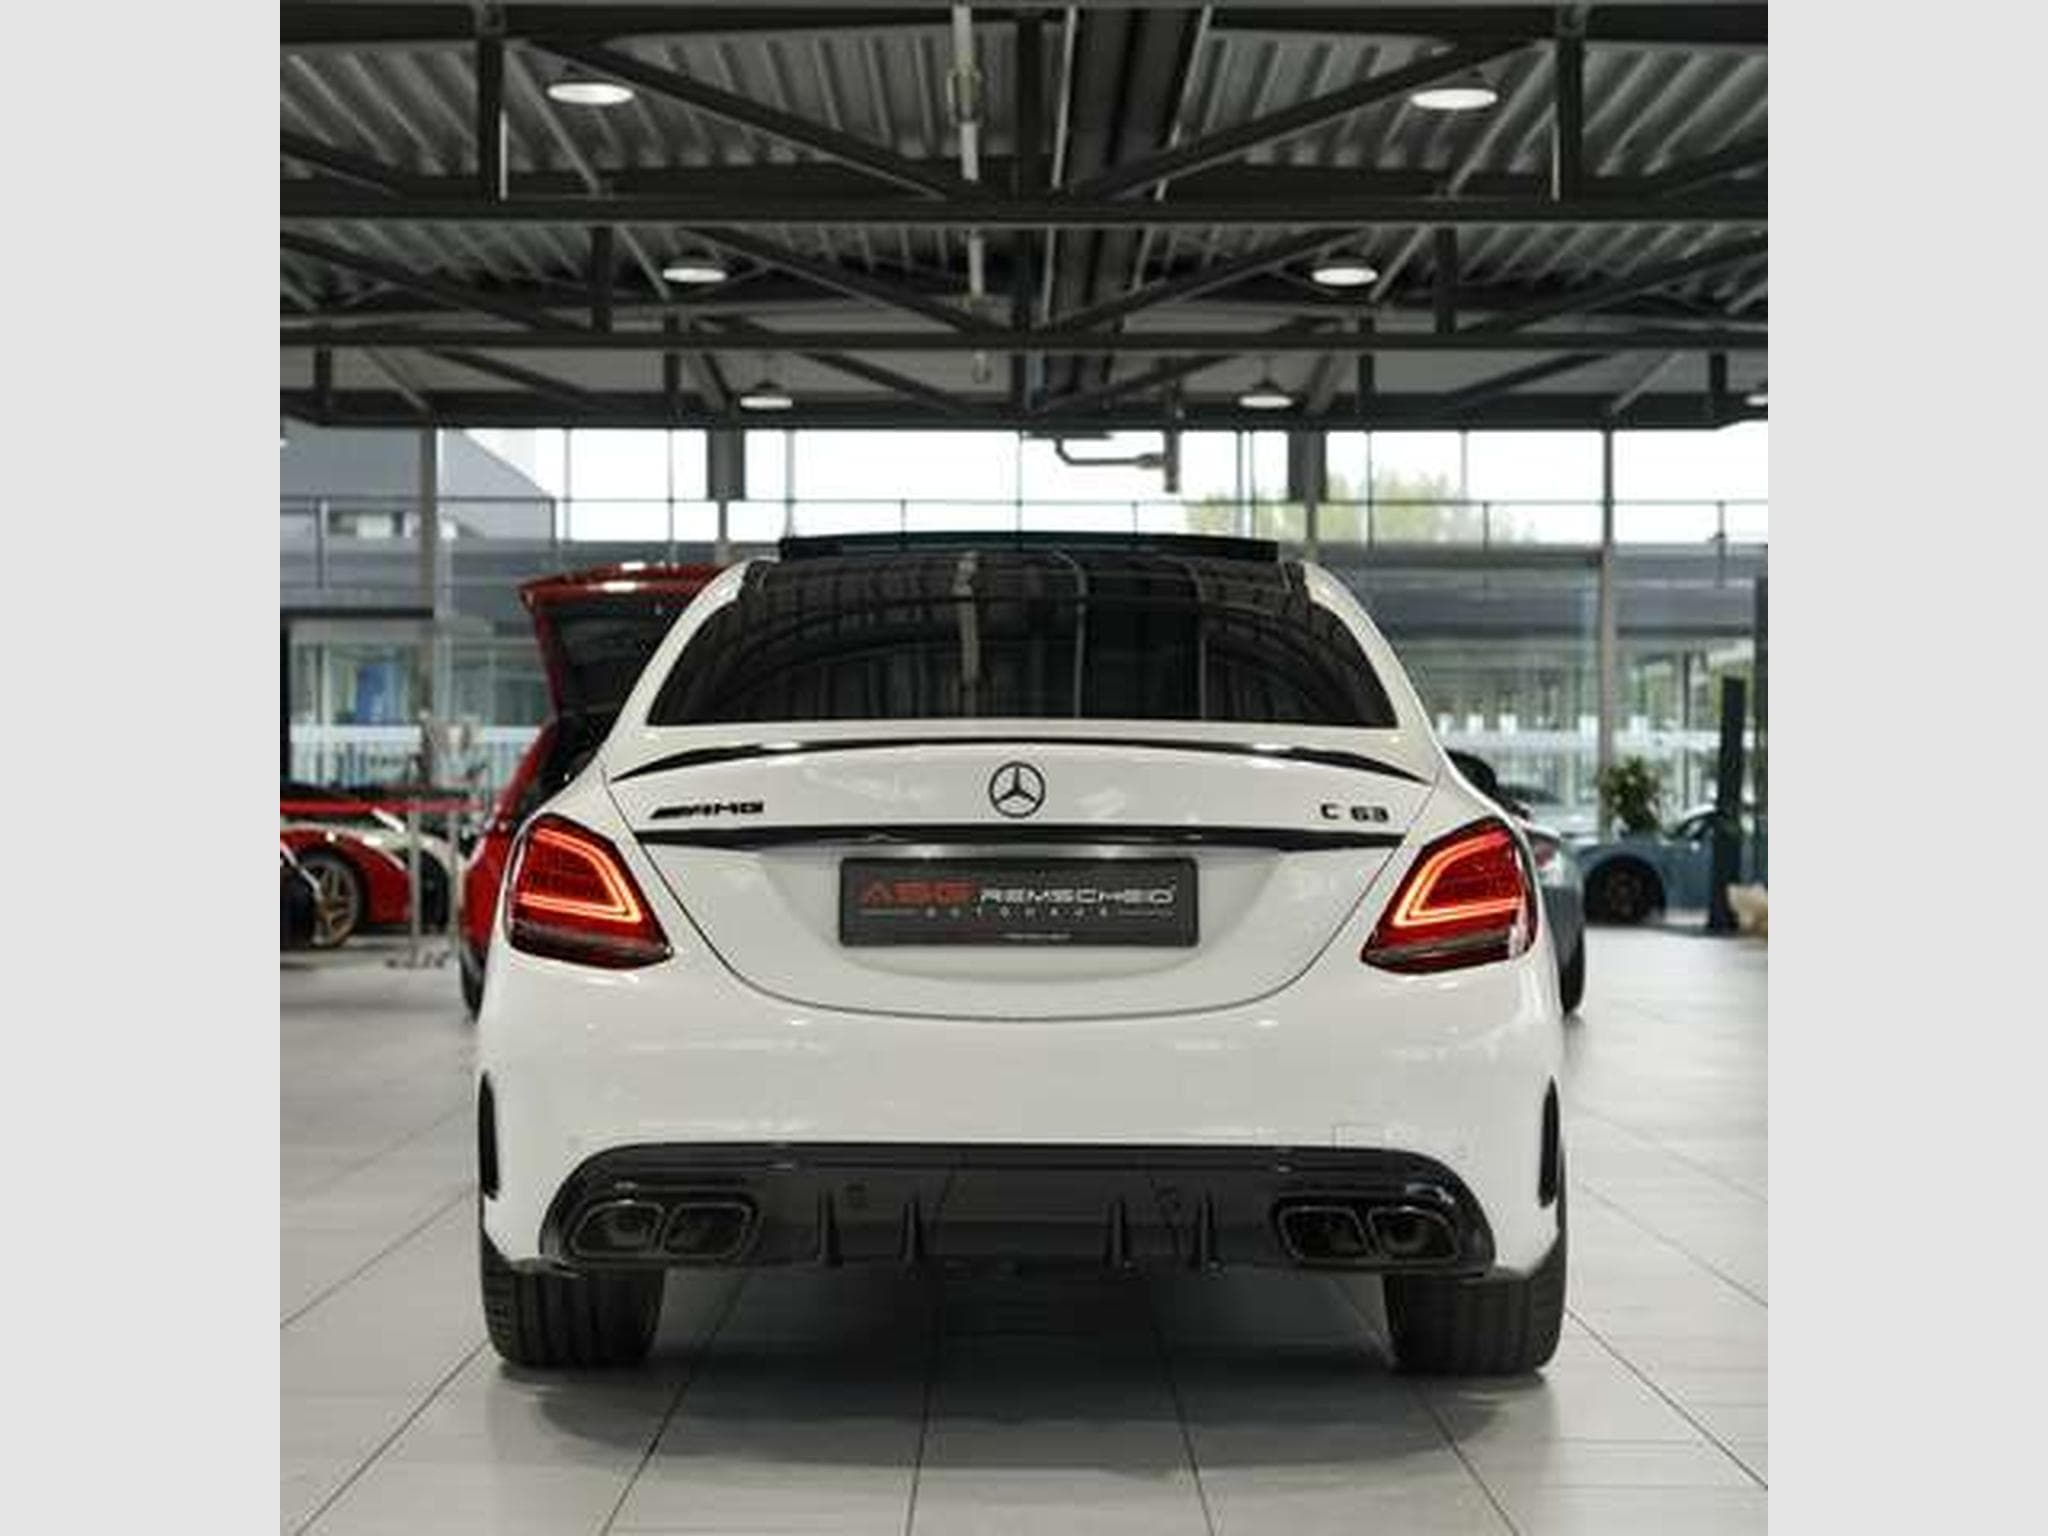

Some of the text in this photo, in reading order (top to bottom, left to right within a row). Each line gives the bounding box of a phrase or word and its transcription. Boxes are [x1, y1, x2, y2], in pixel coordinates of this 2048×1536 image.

[682, 801, 764, 816] AMG
[1320, 802, 1389, 823] C 63
